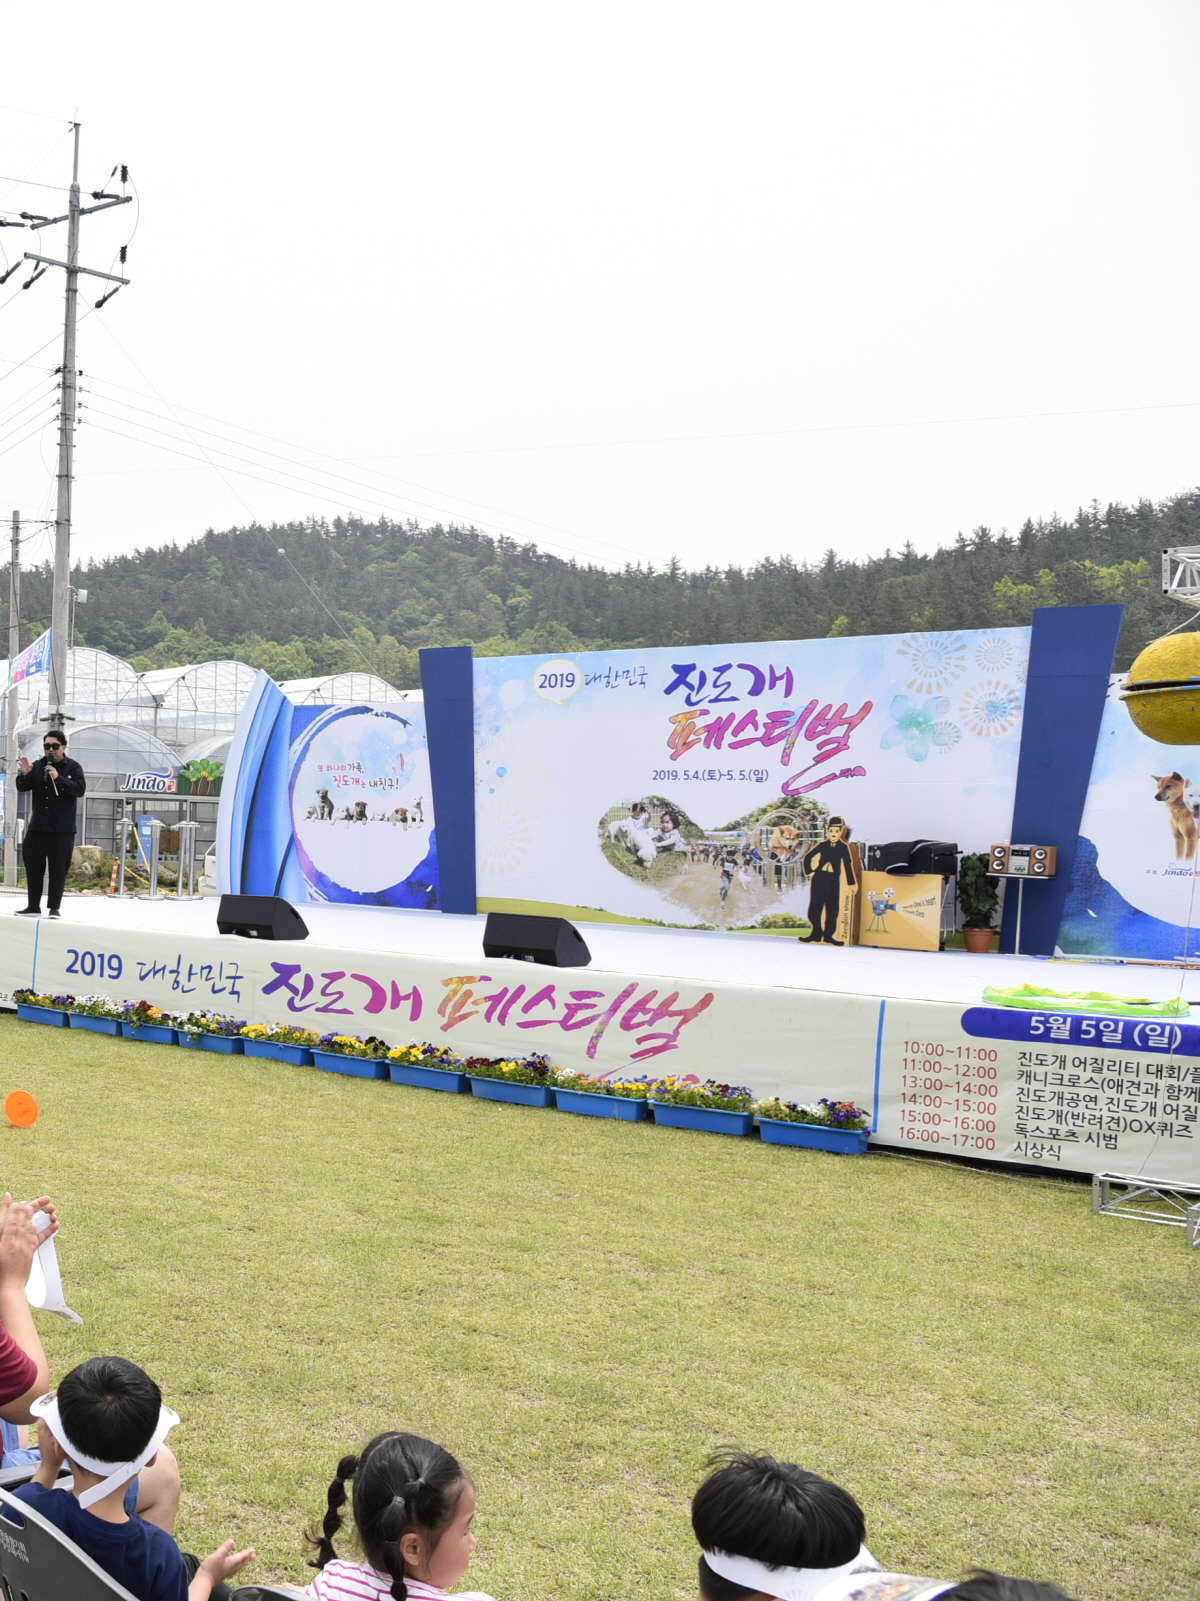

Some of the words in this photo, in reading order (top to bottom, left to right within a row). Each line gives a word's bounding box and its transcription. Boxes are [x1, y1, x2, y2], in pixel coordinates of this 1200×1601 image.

[538, 673, 576, 688] 2019
[584, 665, 648, 689] 대한민국
[664, 662, 794, 706] 진도개
[667, 700, 873, 796] 페스티벌
[121, 774, 166, 792] Jindo
[65, 949, 123, 979] 2019
[136, 954, 244, 1003] 대한민국
[261, 961, 423, 1023] 진도개
[437, 975, 714, 1075] 페스티벌
[1029, 1016, 1071, 1040] 5월
[1080, 1019, 1124, 1044] 5일
[1133, 1022, 1182, 1050] (일)
[902, 1040, 998, 1062] 10:00~11:00
[1017, 1051, 1067, 1072] 진도개
[1071, 1056, 1140, 1079] 어질리티
[902, 1057, 998, 1080] 11:00~12:00
[1016, 1069, 1160, 1099] 캐니크로스(애견과
[1165, 1083, 1200, 1104] 함께
[900, 1091, 997, 1116] 14:00~15:00
[1014, 1105, 1194, 1139] 진도개(반려견)OX퀴즈
[901, 1074, 998, 1098] 13:00~14:00
[1163, 1103, 1198, 1123] 어질
[898, 1126, 996, 1151] 16:00~17:00
[1013, 1141, 1062, 1161] 시상식
[899, 1109, 996, 1133] 15:00~16:00
[1013, 1123, 1080, 1145] 독스포츠
[1084, 1131, 1119, 1151] 시범
